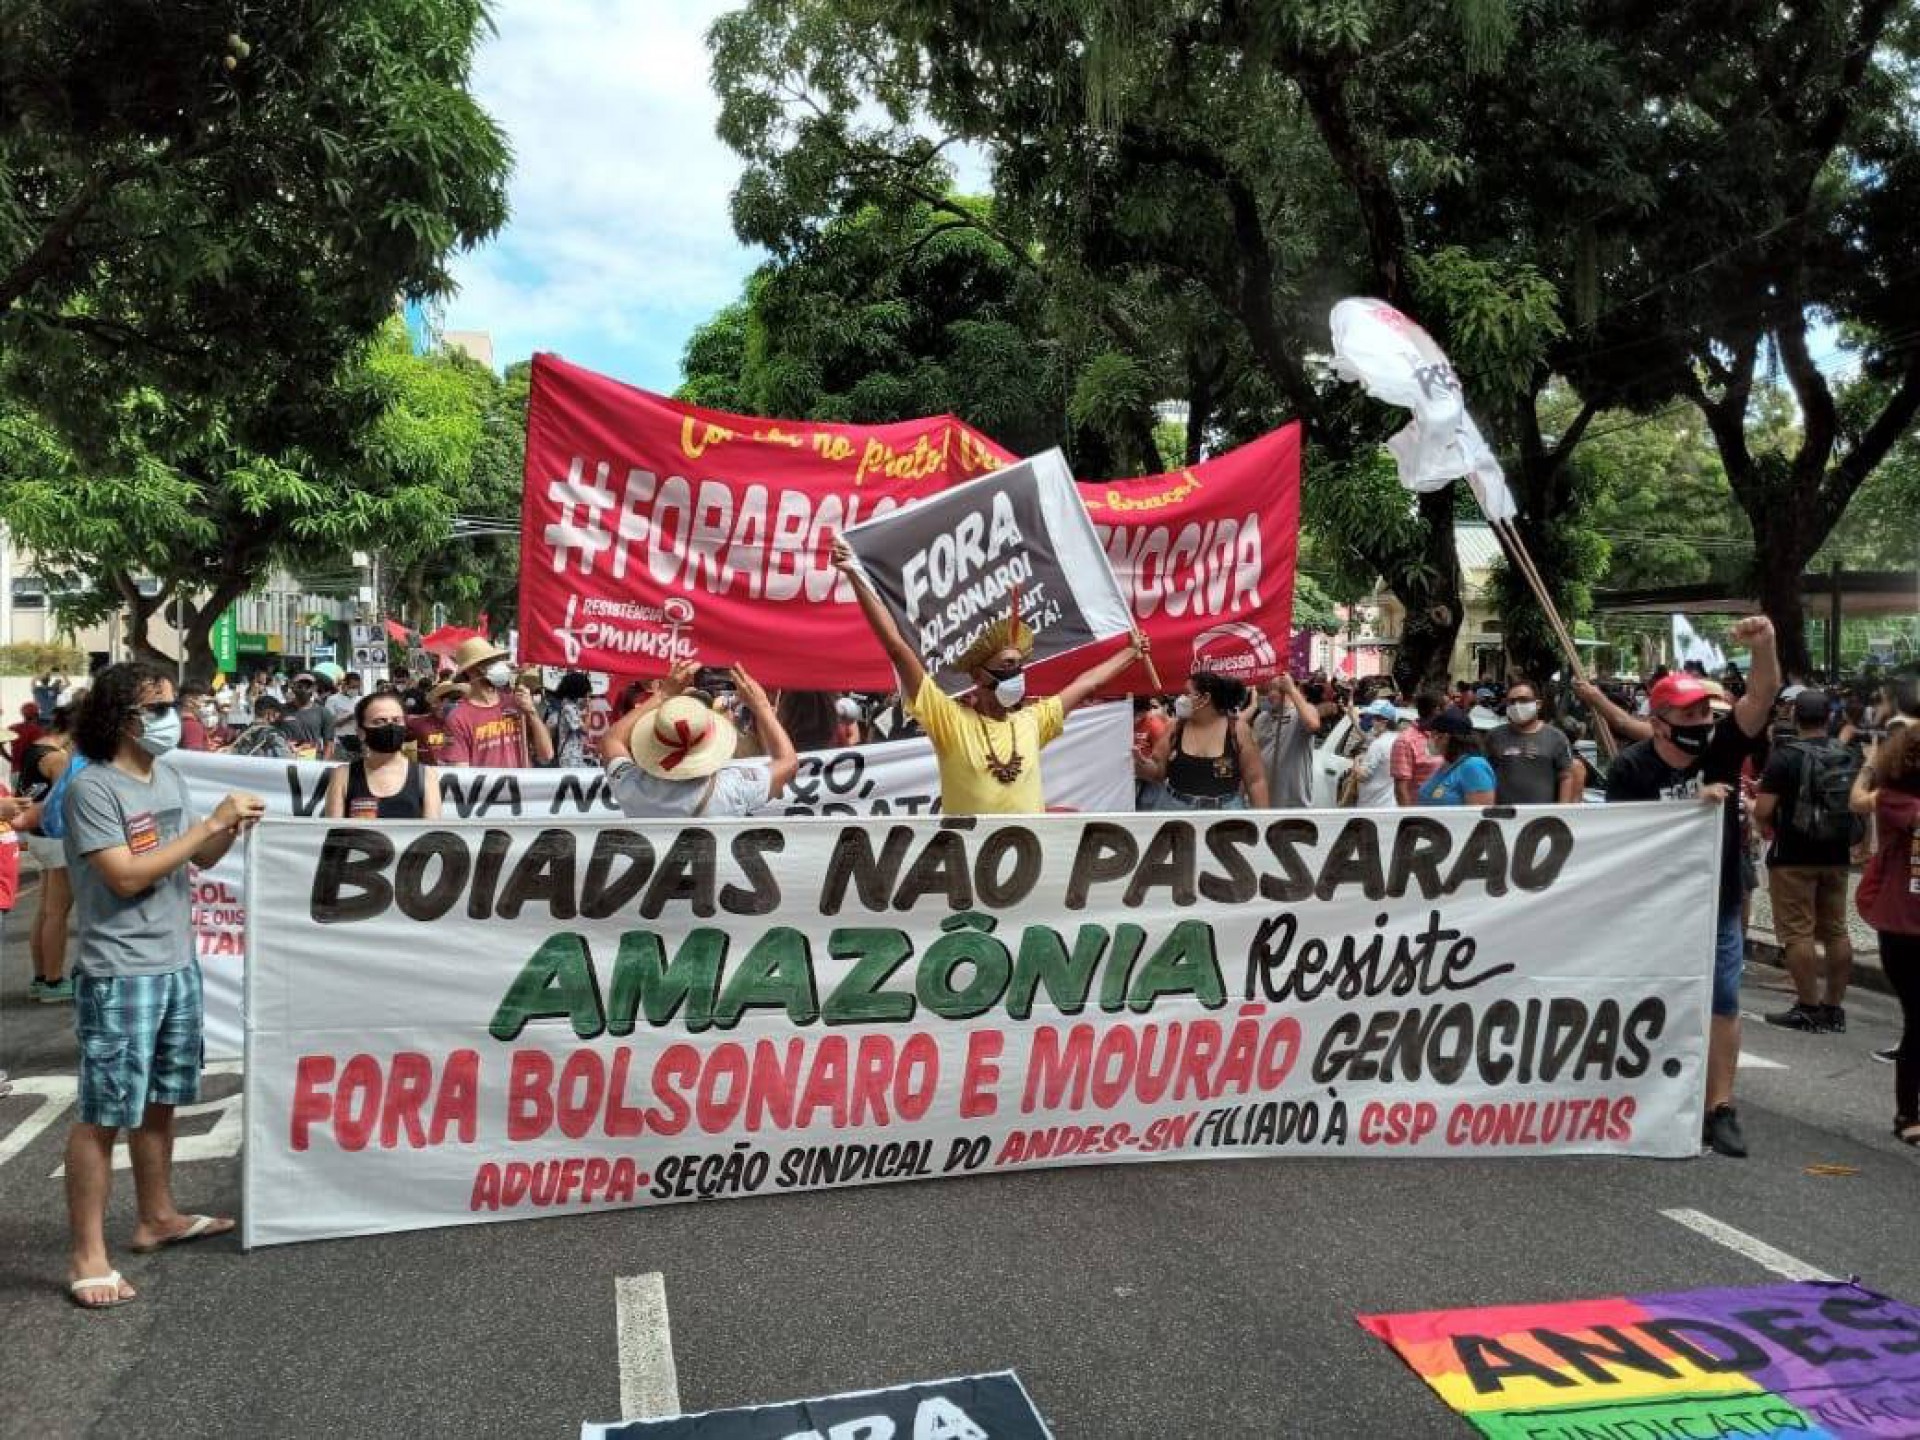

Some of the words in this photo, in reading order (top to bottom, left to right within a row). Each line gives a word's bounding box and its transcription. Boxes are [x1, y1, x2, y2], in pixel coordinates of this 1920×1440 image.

[544, 457, 917, 606] #FORABOL
[901, 491, 1023, 623] FORA
[310, 828, 785, 923] BOIADAS
[819, 816, 1043, 916] NÃO
[1066, 806, 1574, 909] PASSARÃO
[488, 912, 1228, 1042] AMAZÔNIA
[1245, 910, 1516, 1002] Resiste
[289, 1049, 479, 1151] FORA
[507, 1031, 939, 1141] BOLSONARO
[960, 1030, 1005, 1119] E
[1021, 1004, 1300, 1114] MOURÃO
[1312, 996, 1682, 1087] GENOCIDAS.
[776, 1134, 934, 1189] SINDICAL
[943, 1135, 992, 1172] DO
[995, 1112, 1200, 1166] ANDES-SN
[1195, 1100, 1319, 1149] FILIADO
[1322, 1087, 1348, 1146] À
[1359, 1100, 1438, 1146] CSP
[1446, 1095, 1638, 1147] CONLUTAS
[1449, 1297, 1920, 1395] ANDES
